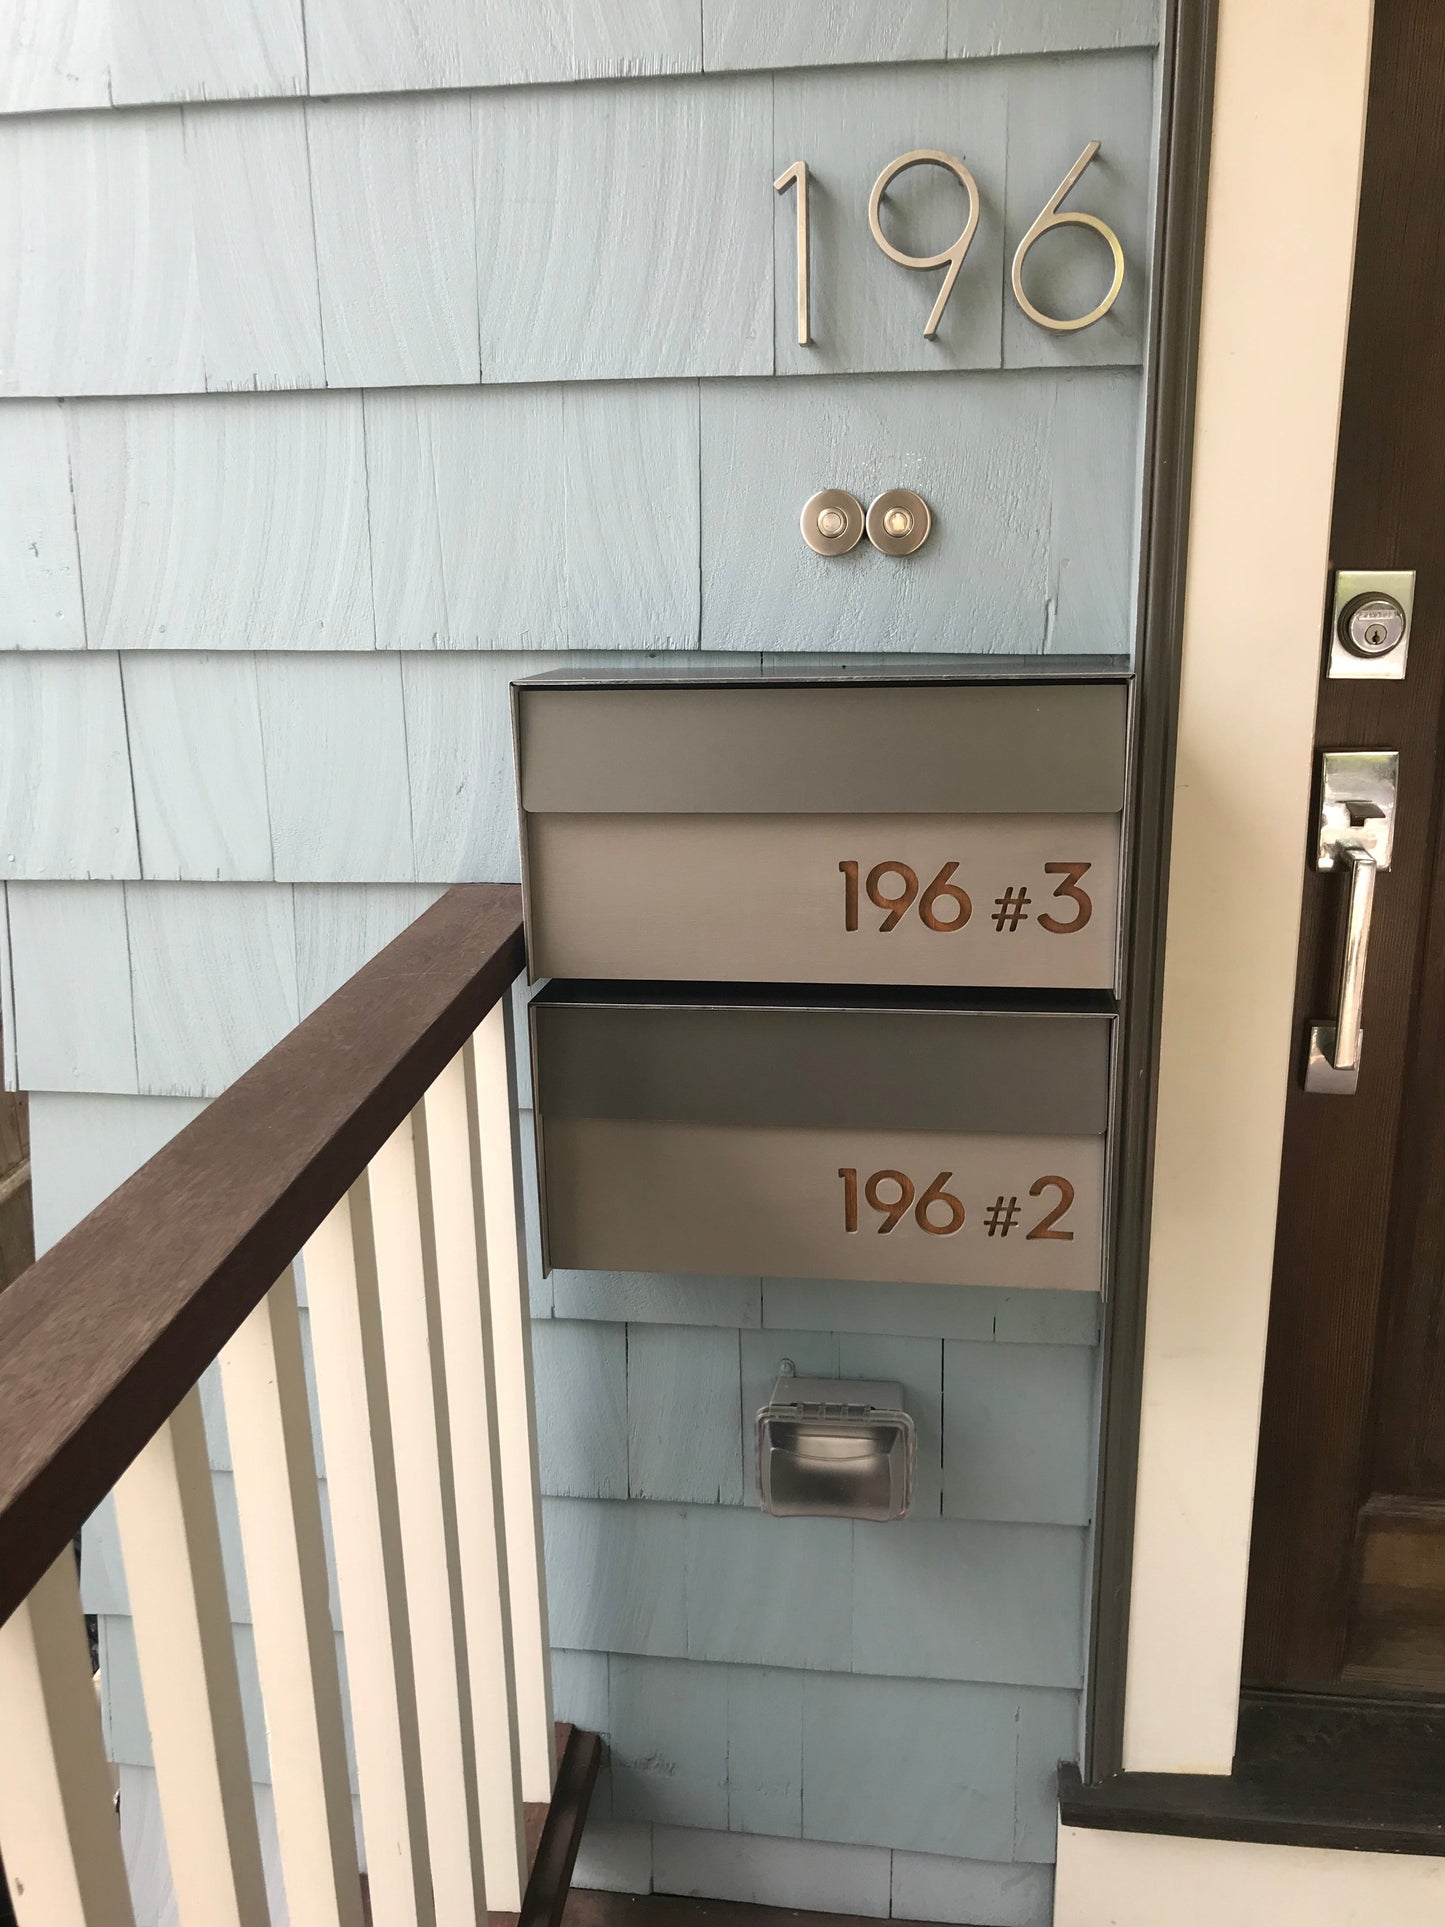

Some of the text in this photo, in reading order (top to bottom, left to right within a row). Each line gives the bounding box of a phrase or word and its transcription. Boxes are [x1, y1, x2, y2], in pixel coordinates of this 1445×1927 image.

[773, 140, 1125, 347] 196
[838, 860, 1093, 934] 196 #3
[837, 1167, 1076, 1241] 196 #2
